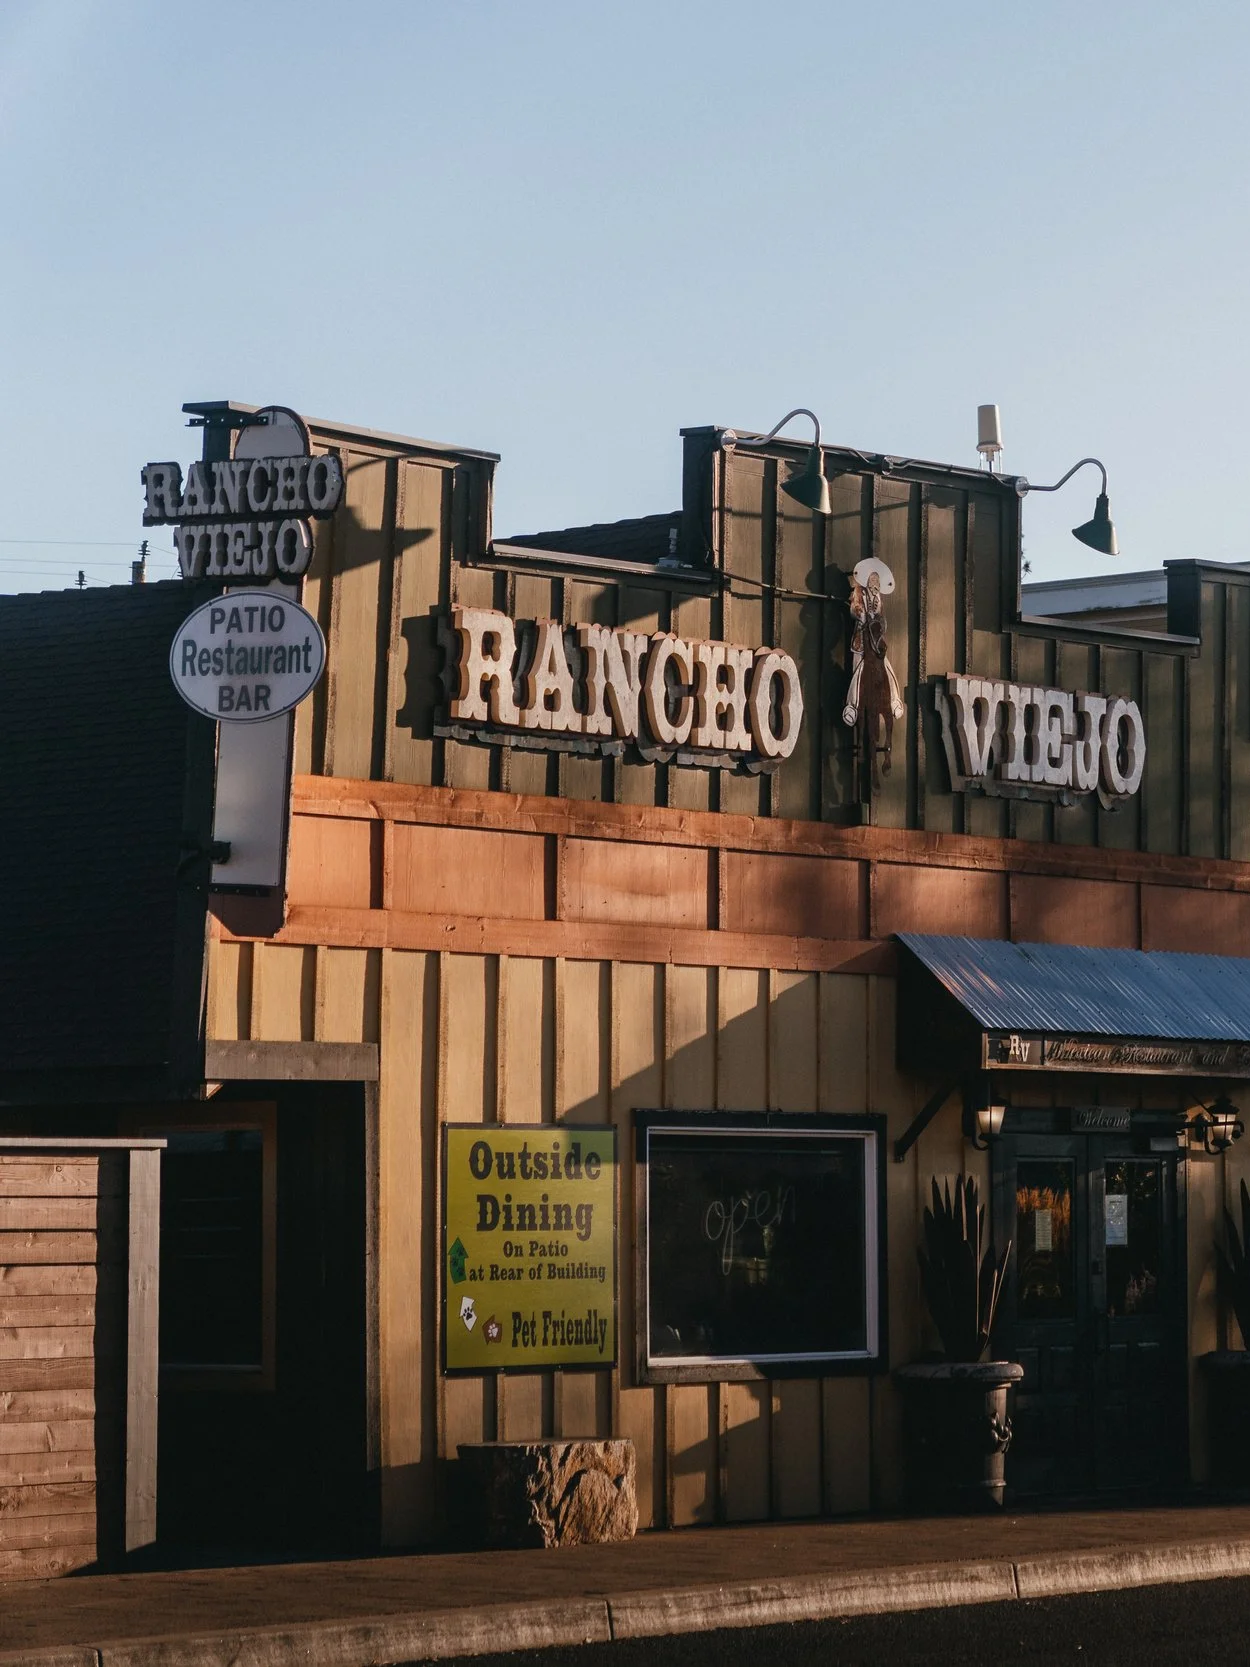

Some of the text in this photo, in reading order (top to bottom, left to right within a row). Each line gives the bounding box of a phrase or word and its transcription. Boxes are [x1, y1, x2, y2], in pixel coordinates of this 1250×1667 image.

[142, 454, 343, 520] RANCHO
[174, 519, 314, 580] VIEJO
[209, 605, 286, 634] PATIO
[181, 635, 312, 677] Restaurant
[217, 684, 271, 713] BAR
[450, 602, 1146, 796] RANCHO VIEJO
[1080, 1107, 1131, 1127] Welcome
[468, 1141, 602, 1180] Outside
[476, 1193, 594, 1241] Dining
[503, 1240, 569, 1257] On Patio
[469, 1263, 606, 1283] at Rear of Building
[511, 1309, 607, 1354] Pet Friendly
